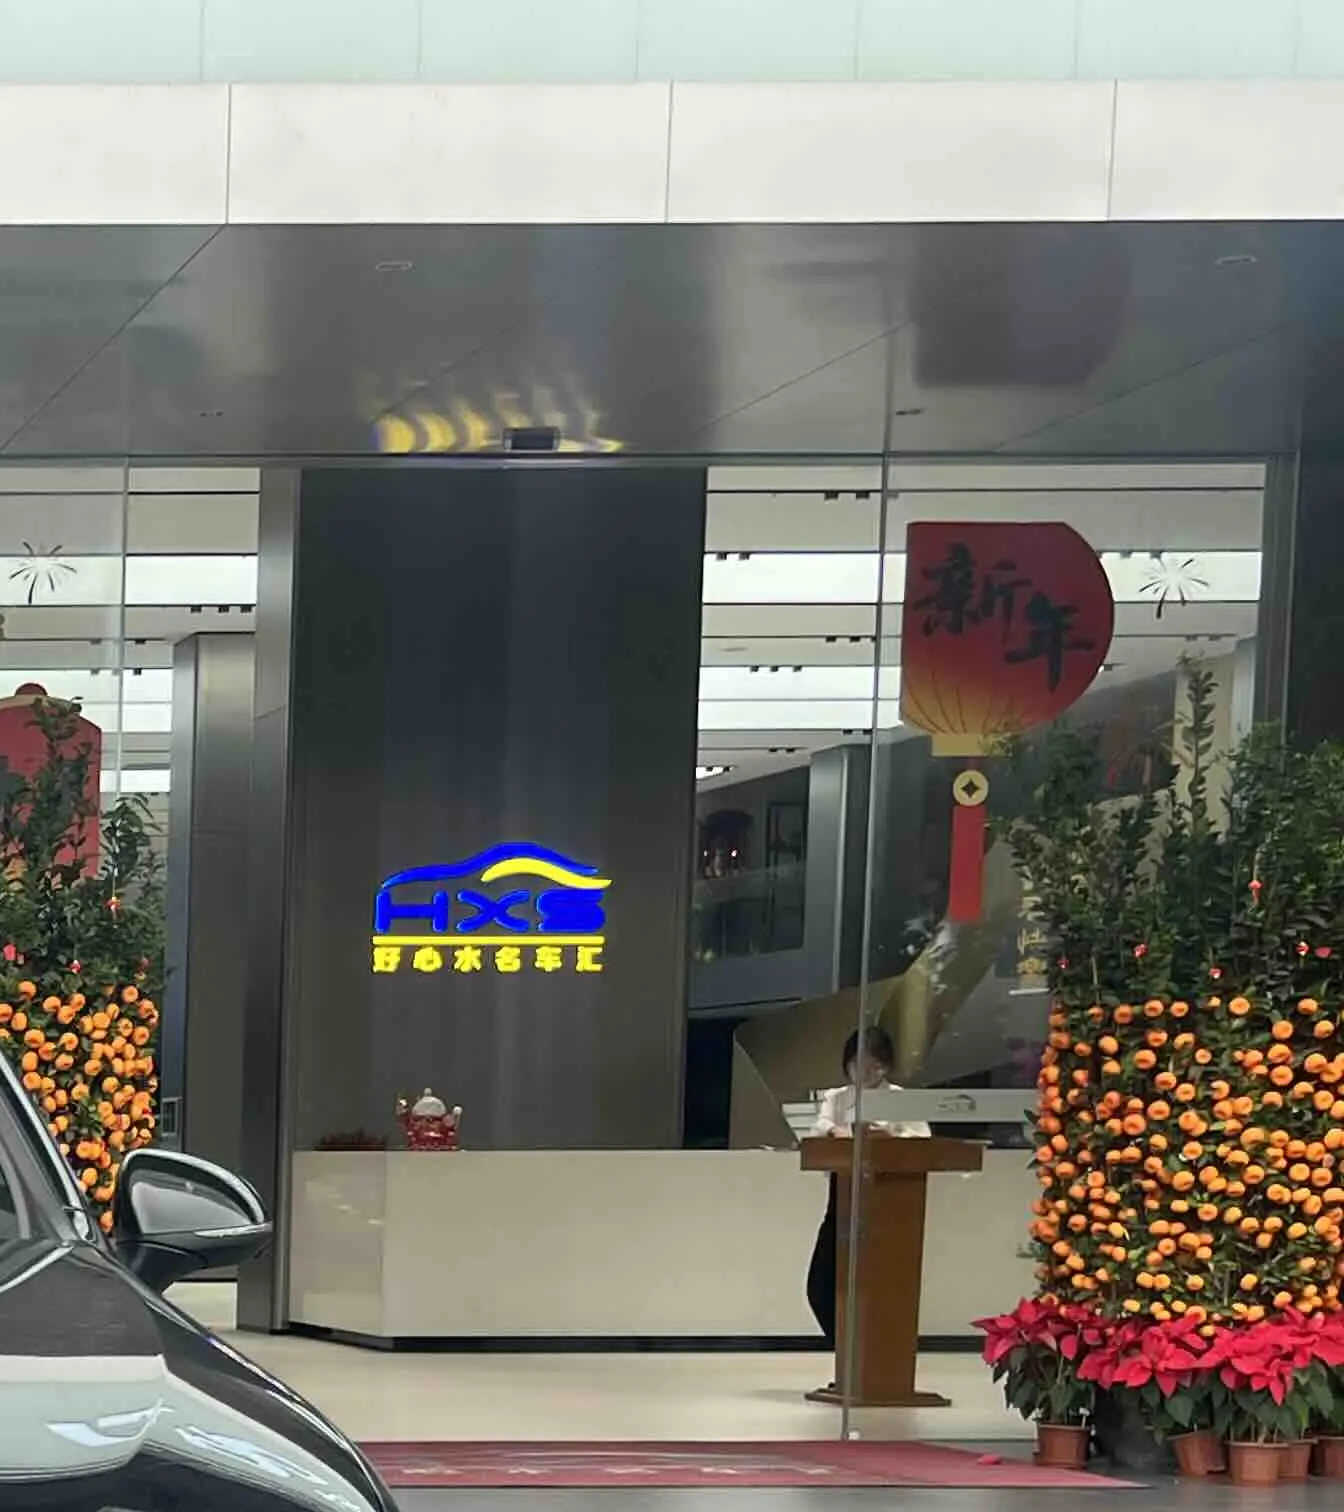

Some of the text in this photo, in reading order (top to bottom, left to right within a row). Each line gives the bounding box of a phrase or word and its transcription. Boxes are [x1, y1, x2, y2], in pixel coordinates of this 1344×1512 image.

[913, 540, 1095, 695] 新年
[374, 888, 606, 934] HXS
[372, 946, 605, 973] 好心水名车汇
